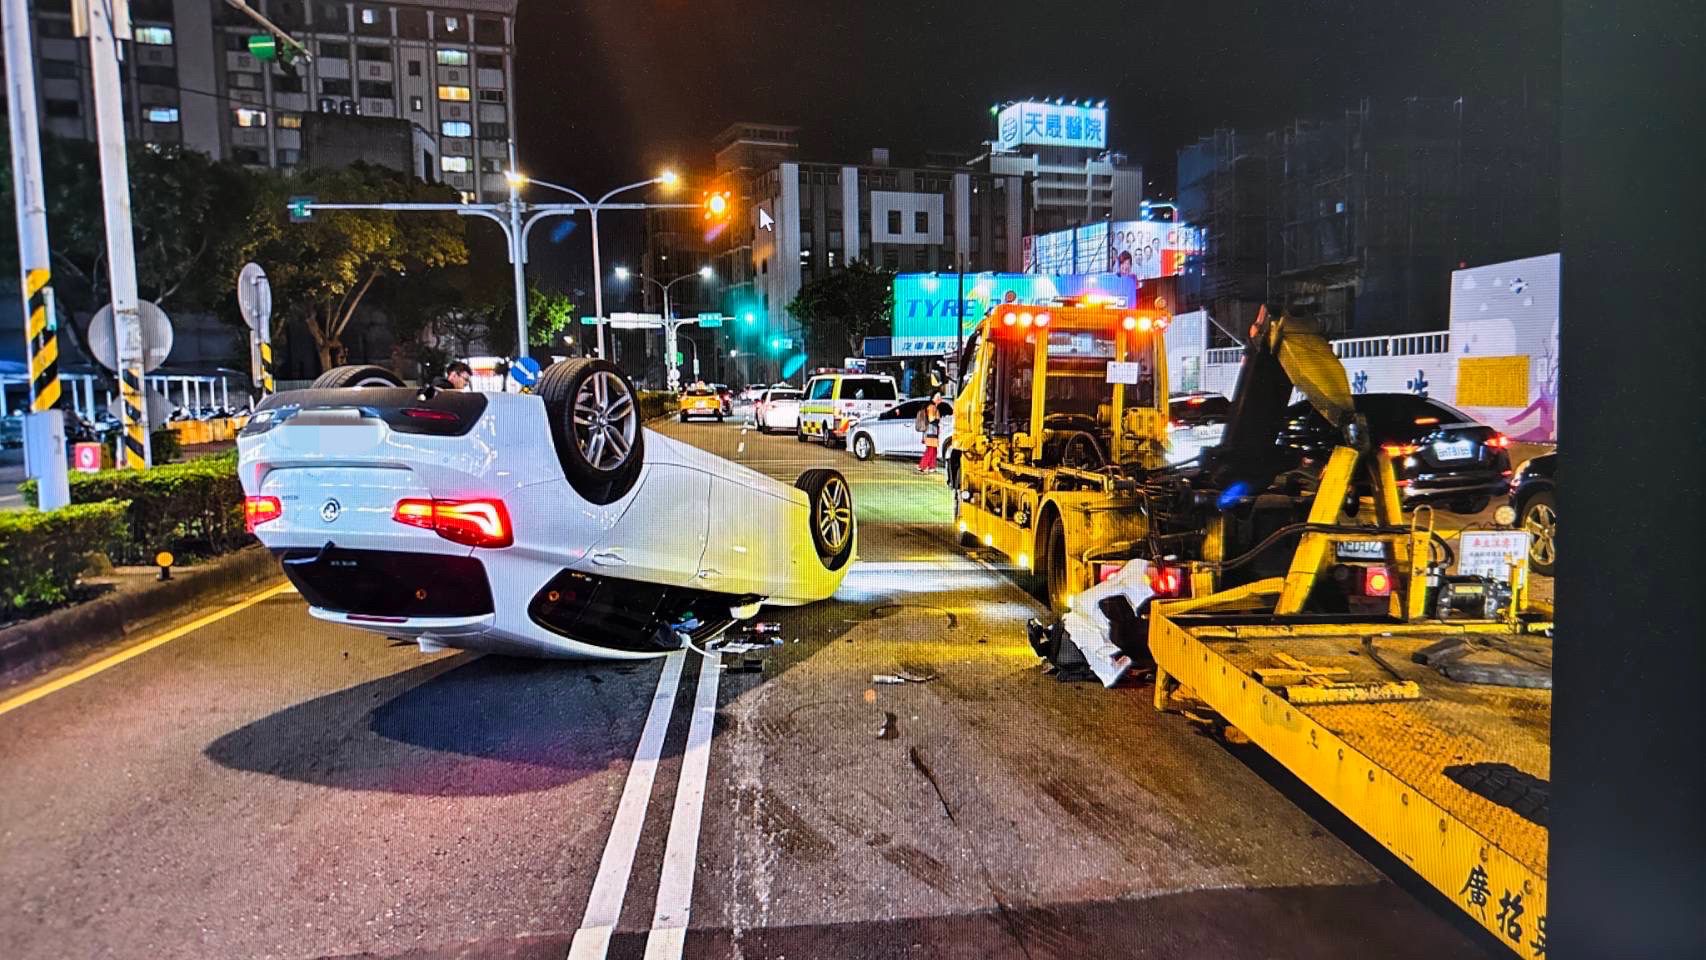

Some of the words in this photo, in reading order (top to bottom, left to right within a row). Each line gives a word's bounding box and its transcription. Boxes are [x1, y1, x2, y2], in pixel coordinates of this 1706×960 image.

[1025, 112, 1102, 141] 天晟醫院
[906, 298, 976, 318] TYRE
